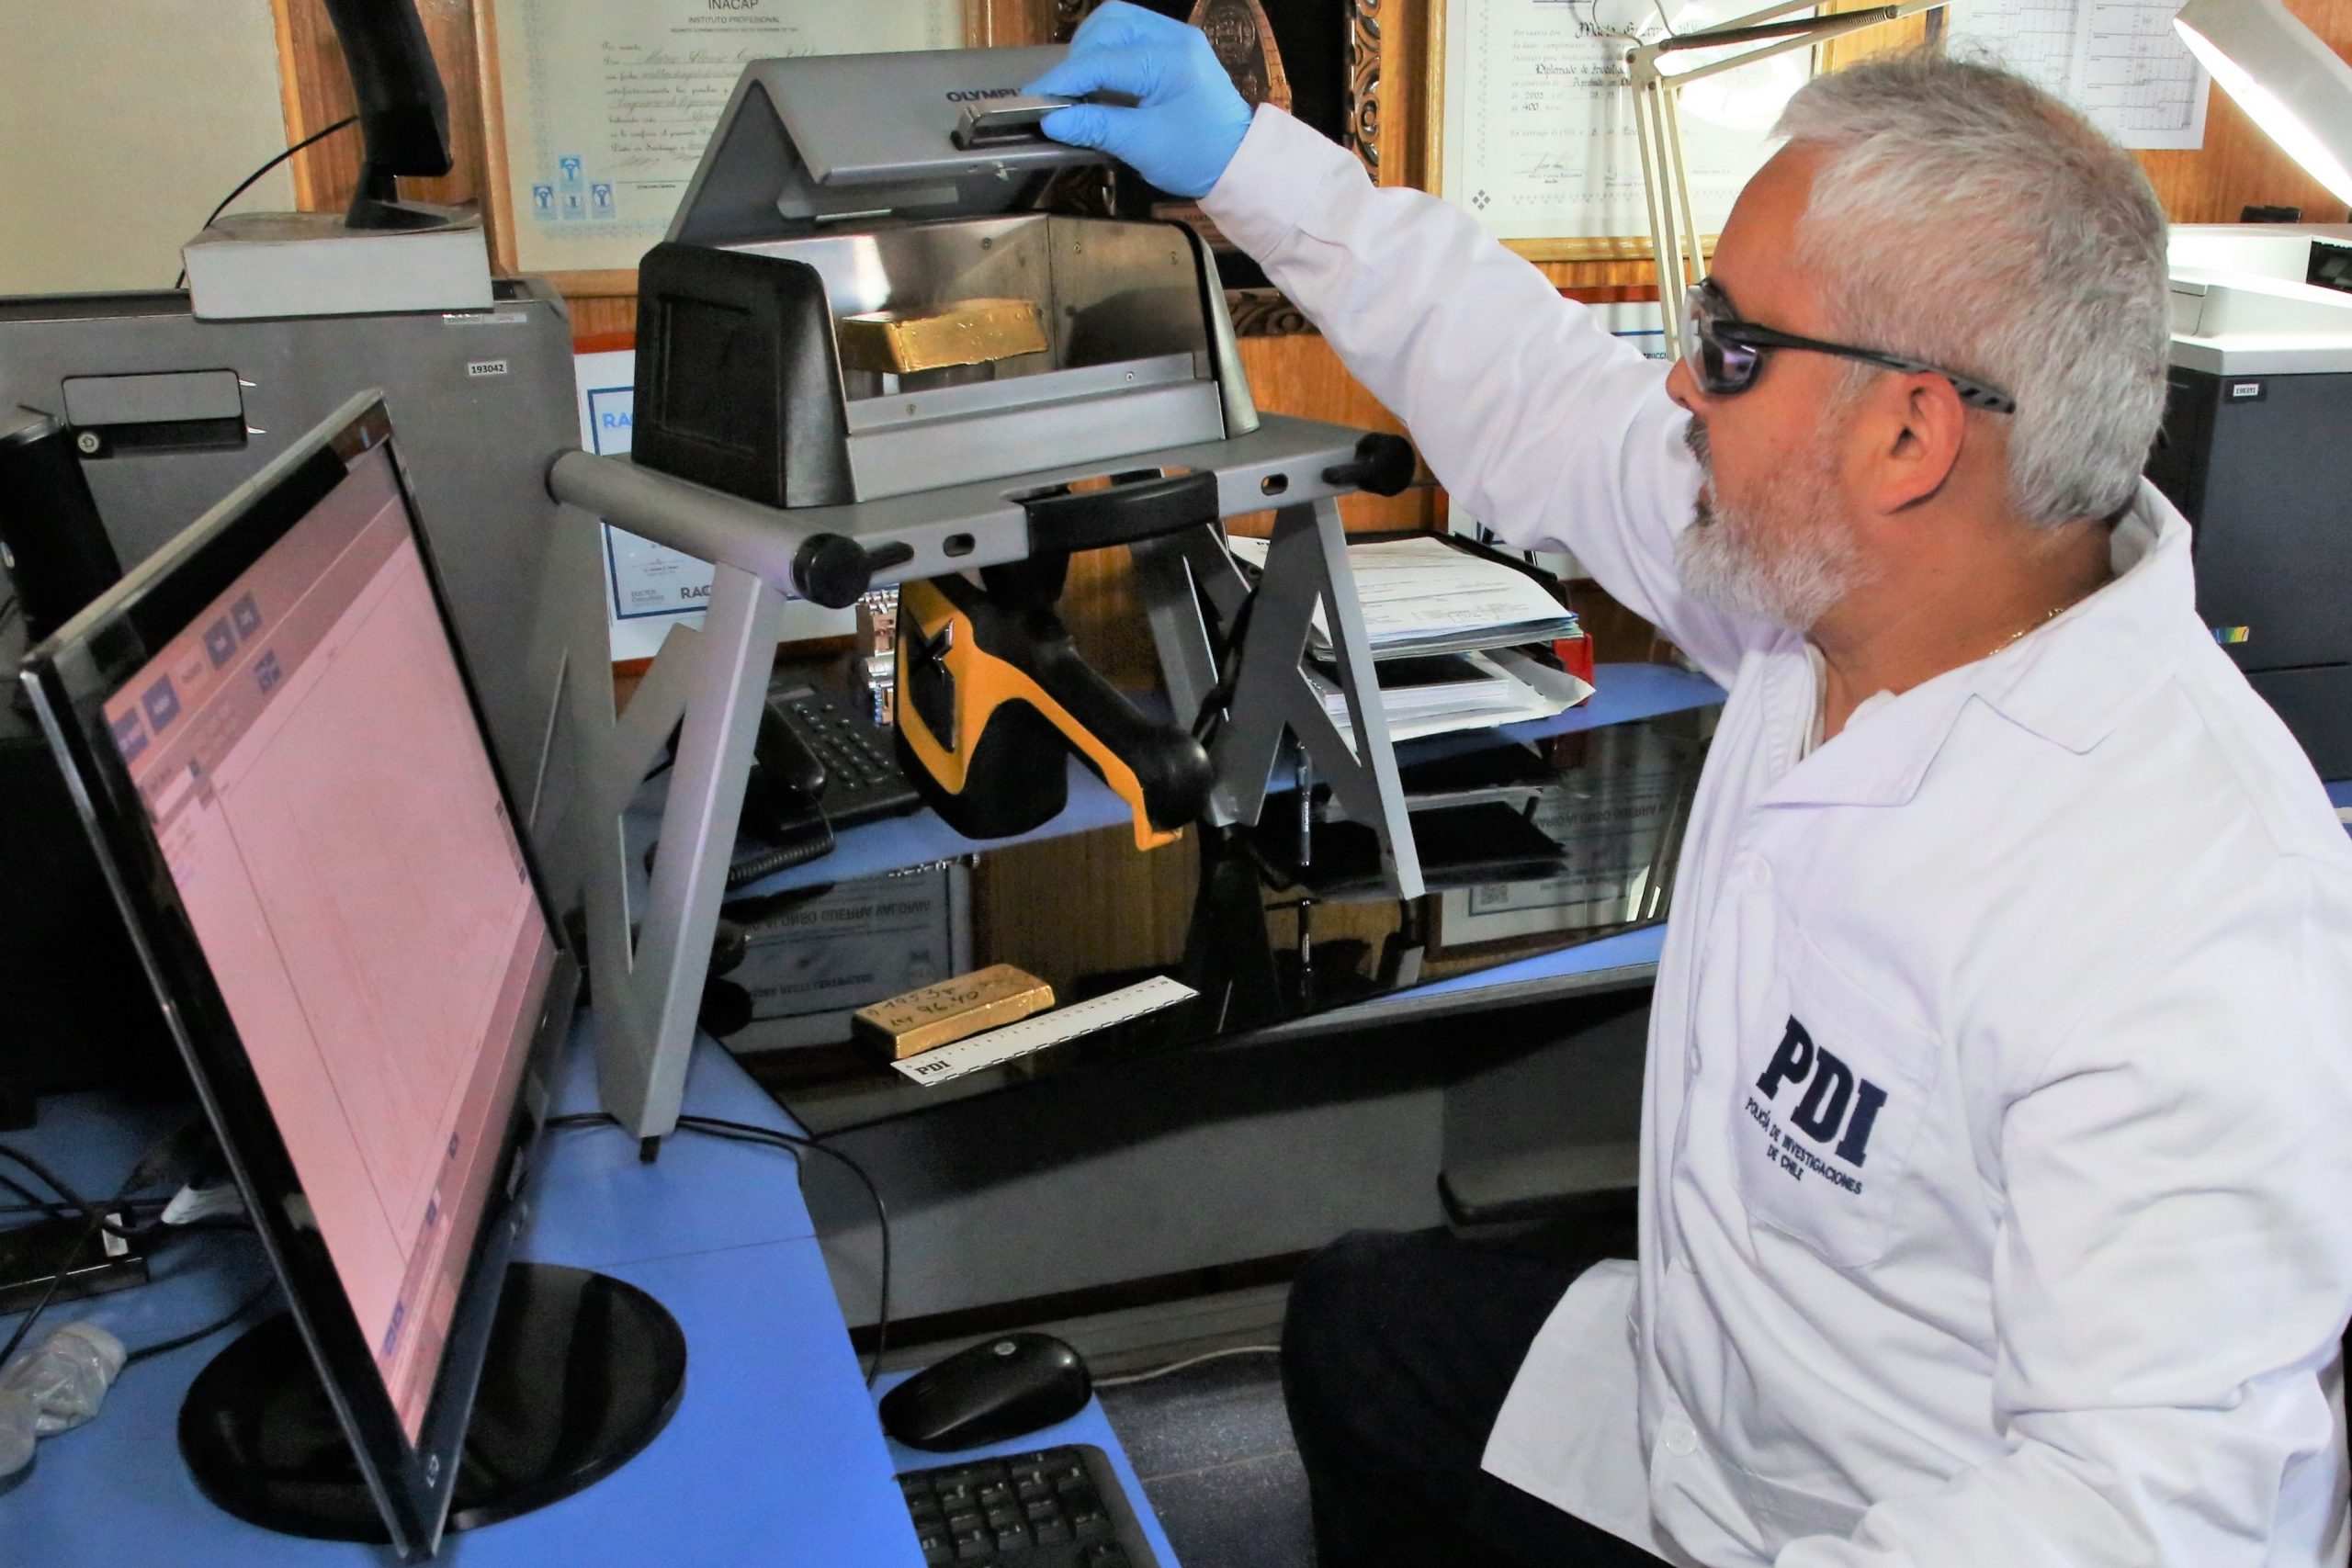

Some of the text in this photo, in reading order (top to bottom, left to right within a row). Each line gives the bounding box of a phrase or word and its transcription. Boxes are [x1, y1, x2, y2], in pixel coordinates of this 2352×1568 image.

[707, 0, 759, 10] INACAP
[688, 16, 780, 24] INSTITUTO PROFESIONAL
[946, 88, 1022, 103] OLYMP
[471, 364, 504, 375] 193042
[603, 412, 634, 429] RA
[914, 1059, 952, 1076] PDI
[1756, 1013, 1889, 1168] PDI
[1745, 1097, 1864, 1195] POLICÍA DE INVESTIGACIONES
[1766, 1144, 1804, 1182] DE CHILE
